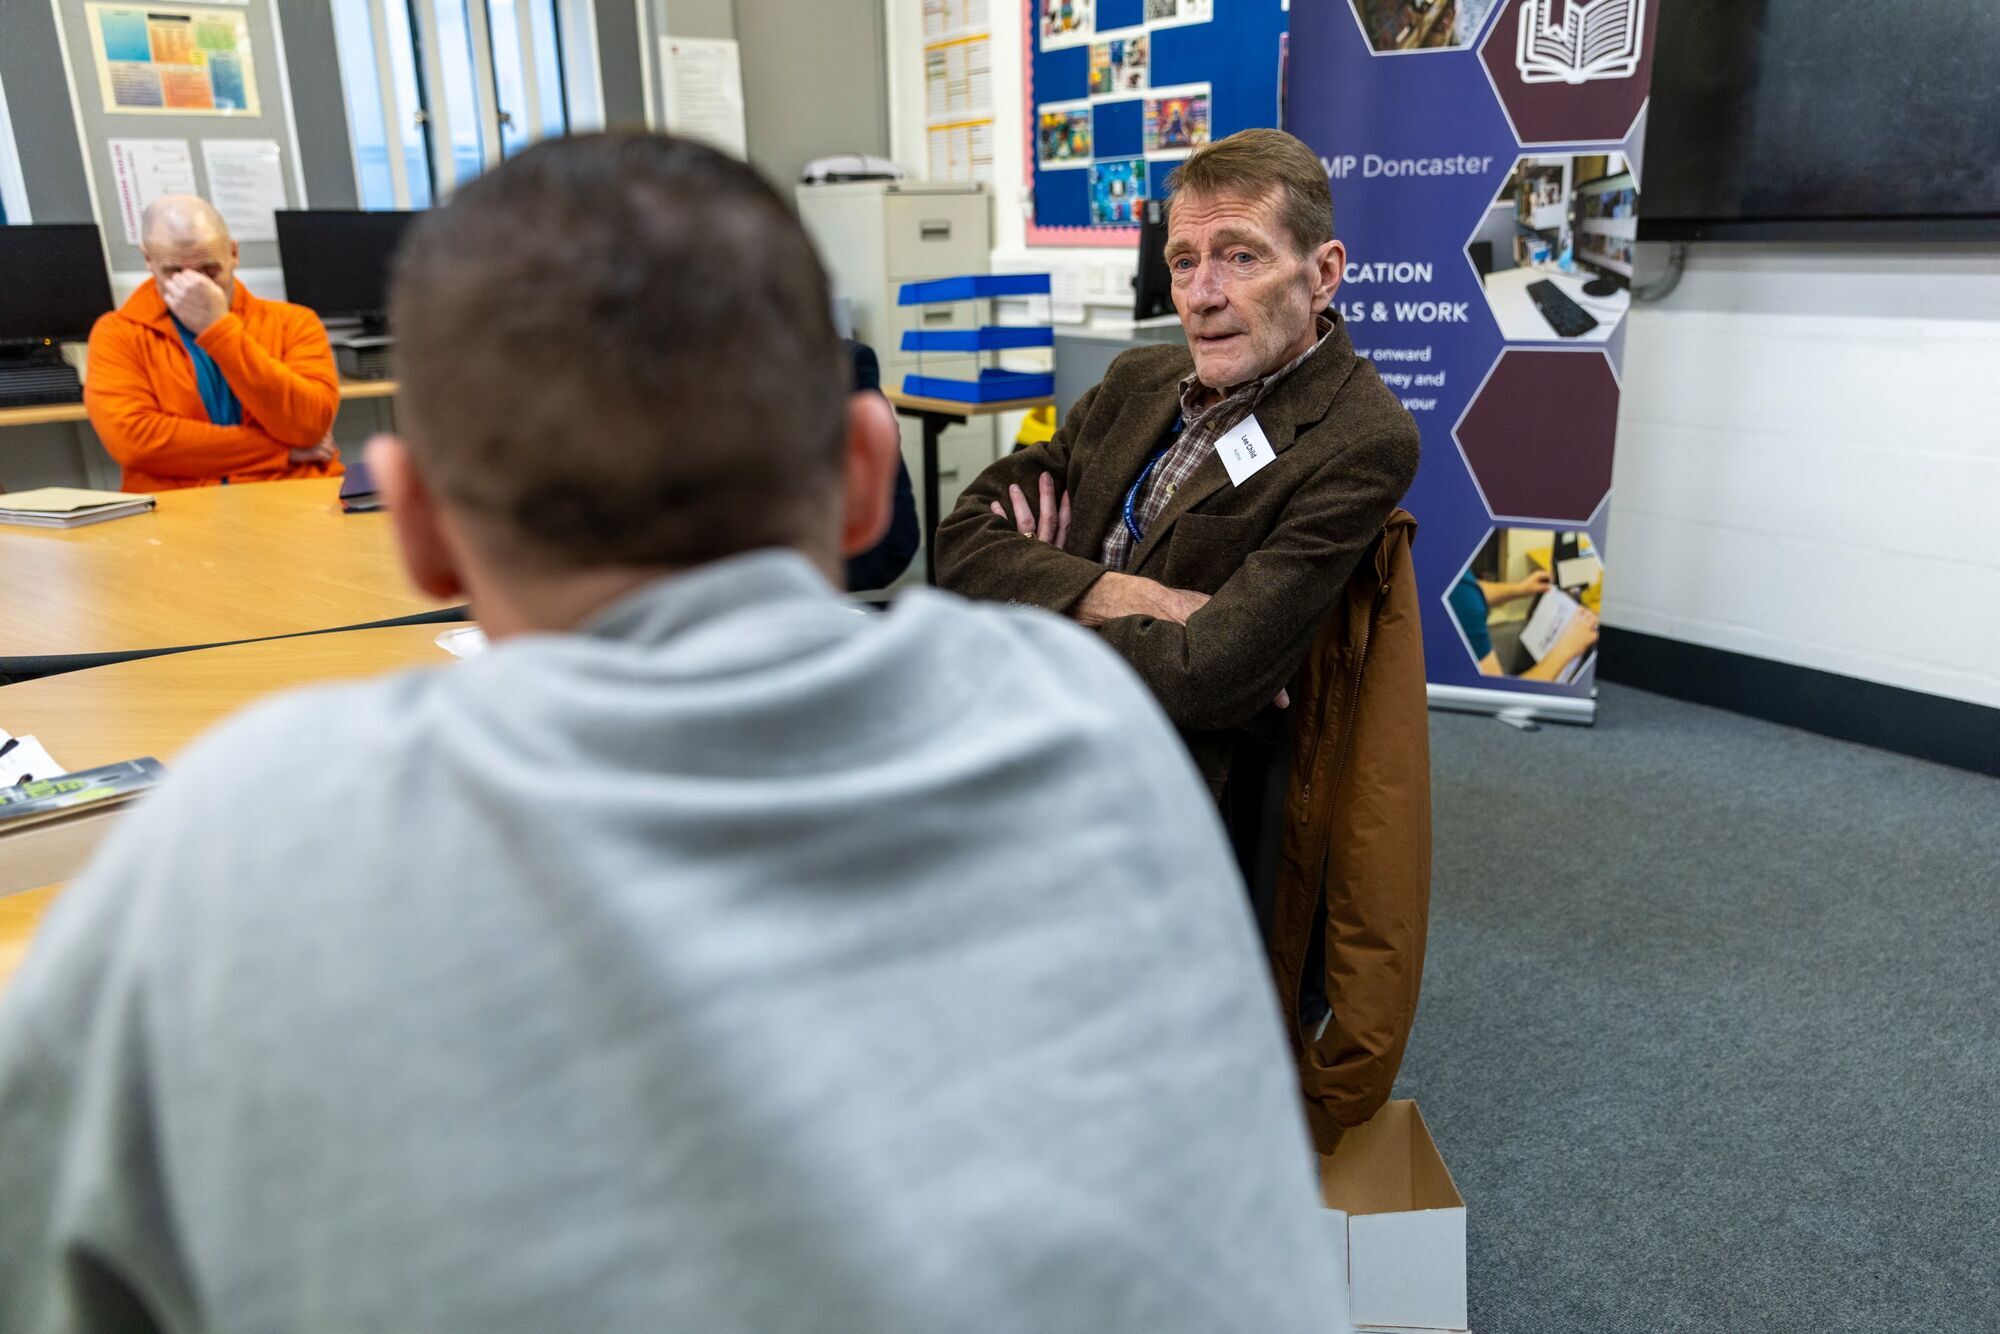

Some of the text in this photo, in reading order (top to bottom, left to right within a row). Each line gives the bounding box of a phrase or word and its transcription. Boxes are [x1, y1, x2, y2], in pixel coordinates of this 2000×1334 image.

[1363, 153, 1493, 178] Doncaster
[1330, 301, 1469, 323] LS & WORK
[1372, 345, 1431, 362] onward
[1414, 370, 1446, 387] and
[1241, 434, 1257, 459] Lee Child
